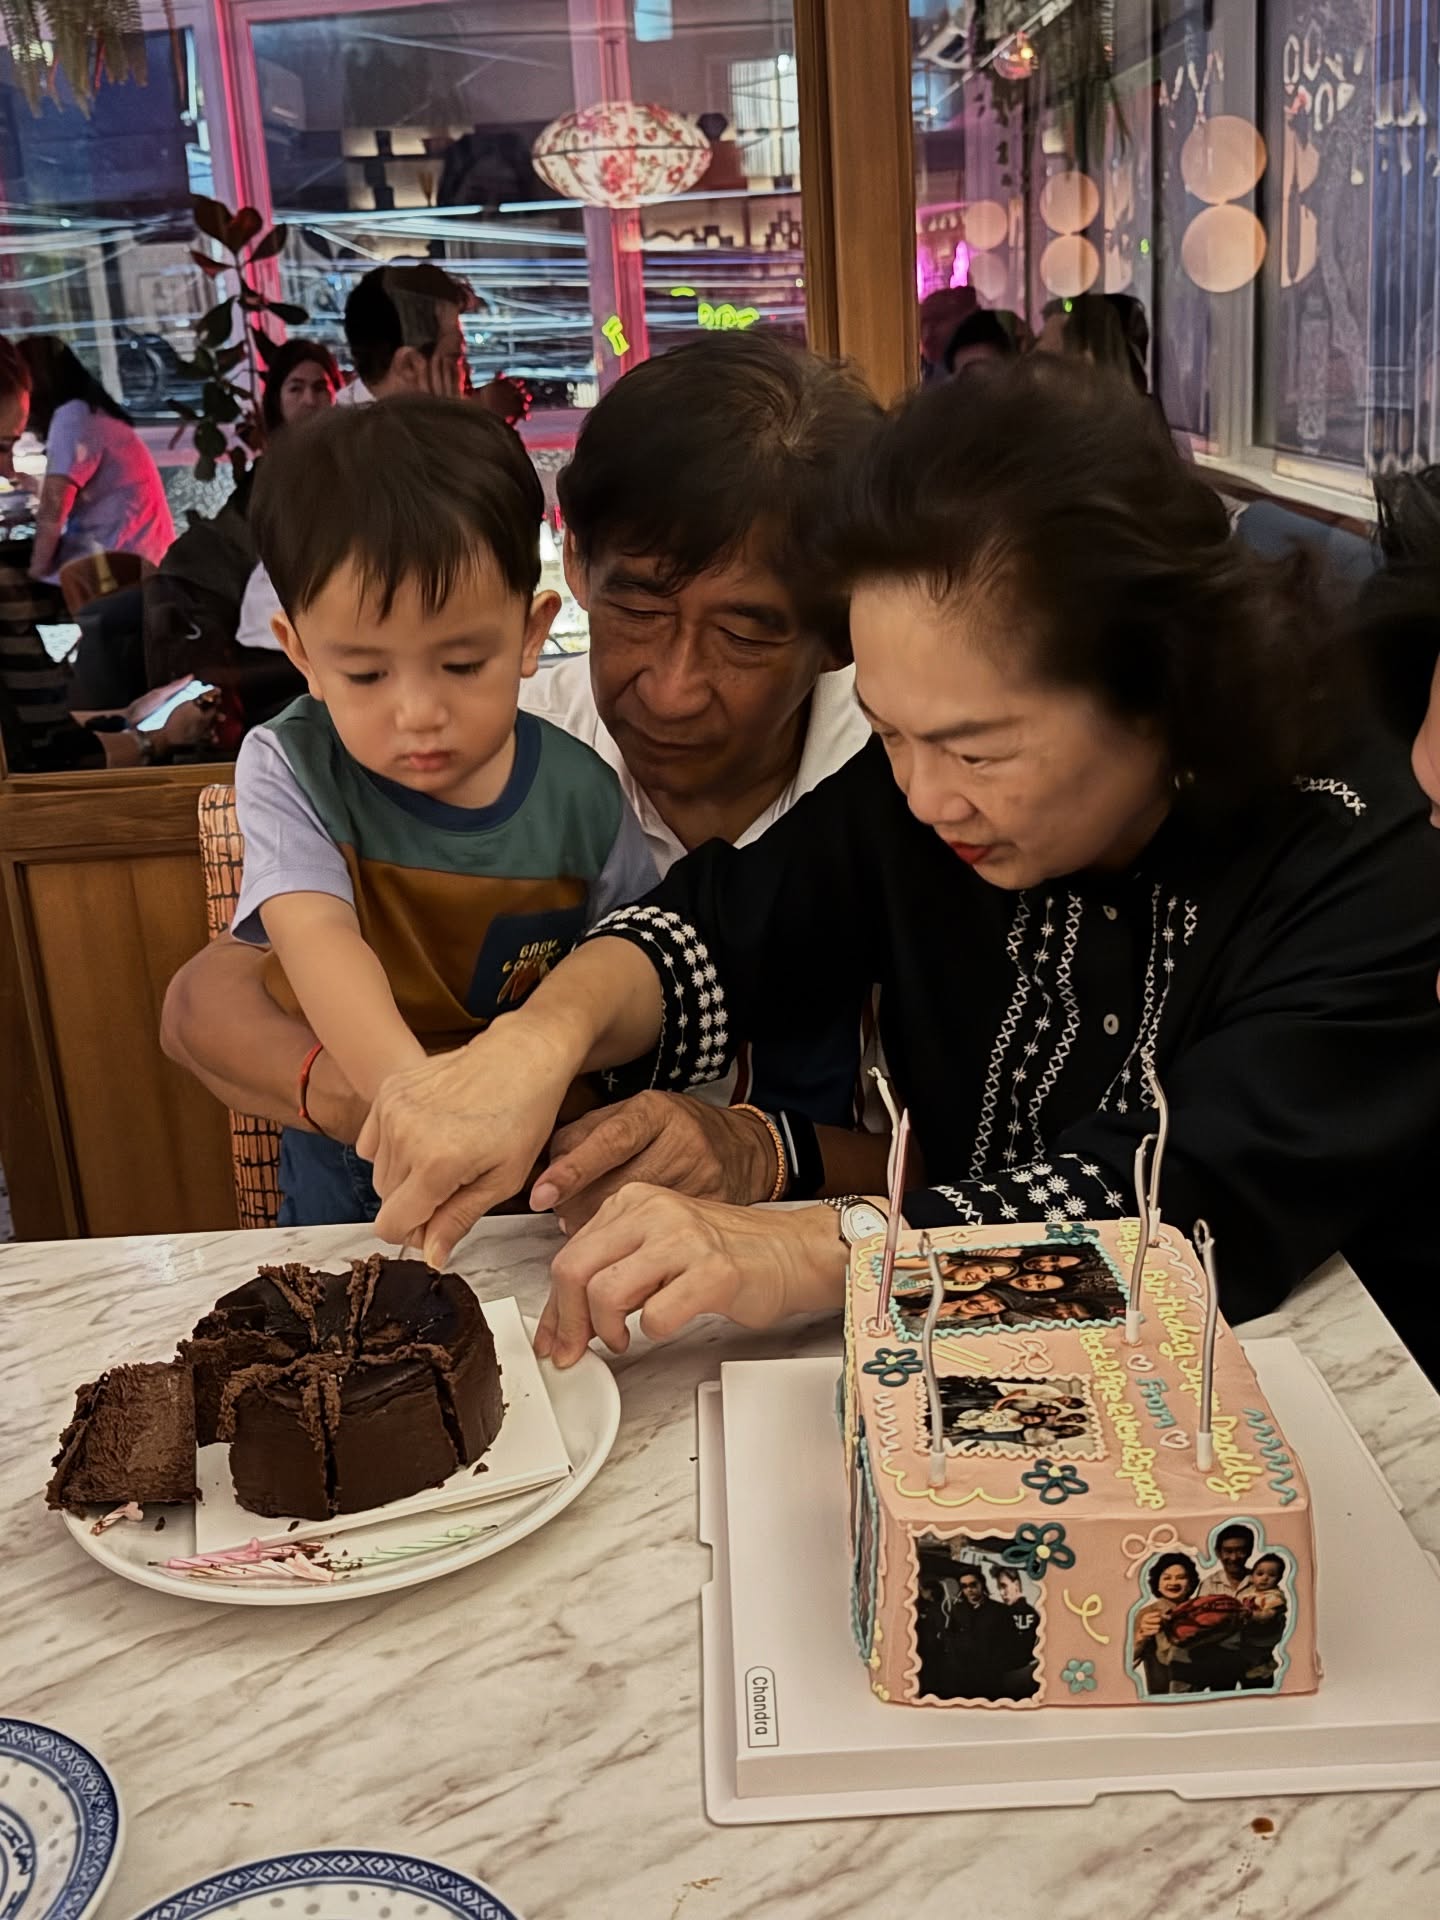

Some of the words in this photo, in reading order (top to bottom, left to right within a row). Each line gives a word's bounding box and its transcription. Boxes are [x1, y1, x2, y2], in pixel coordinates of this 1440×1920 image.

[1143, 1269, 1200, 1360] Birthday
[1136, 1377, 1177, 1428] From
[752, 1676, 771, 1735] Chandra
